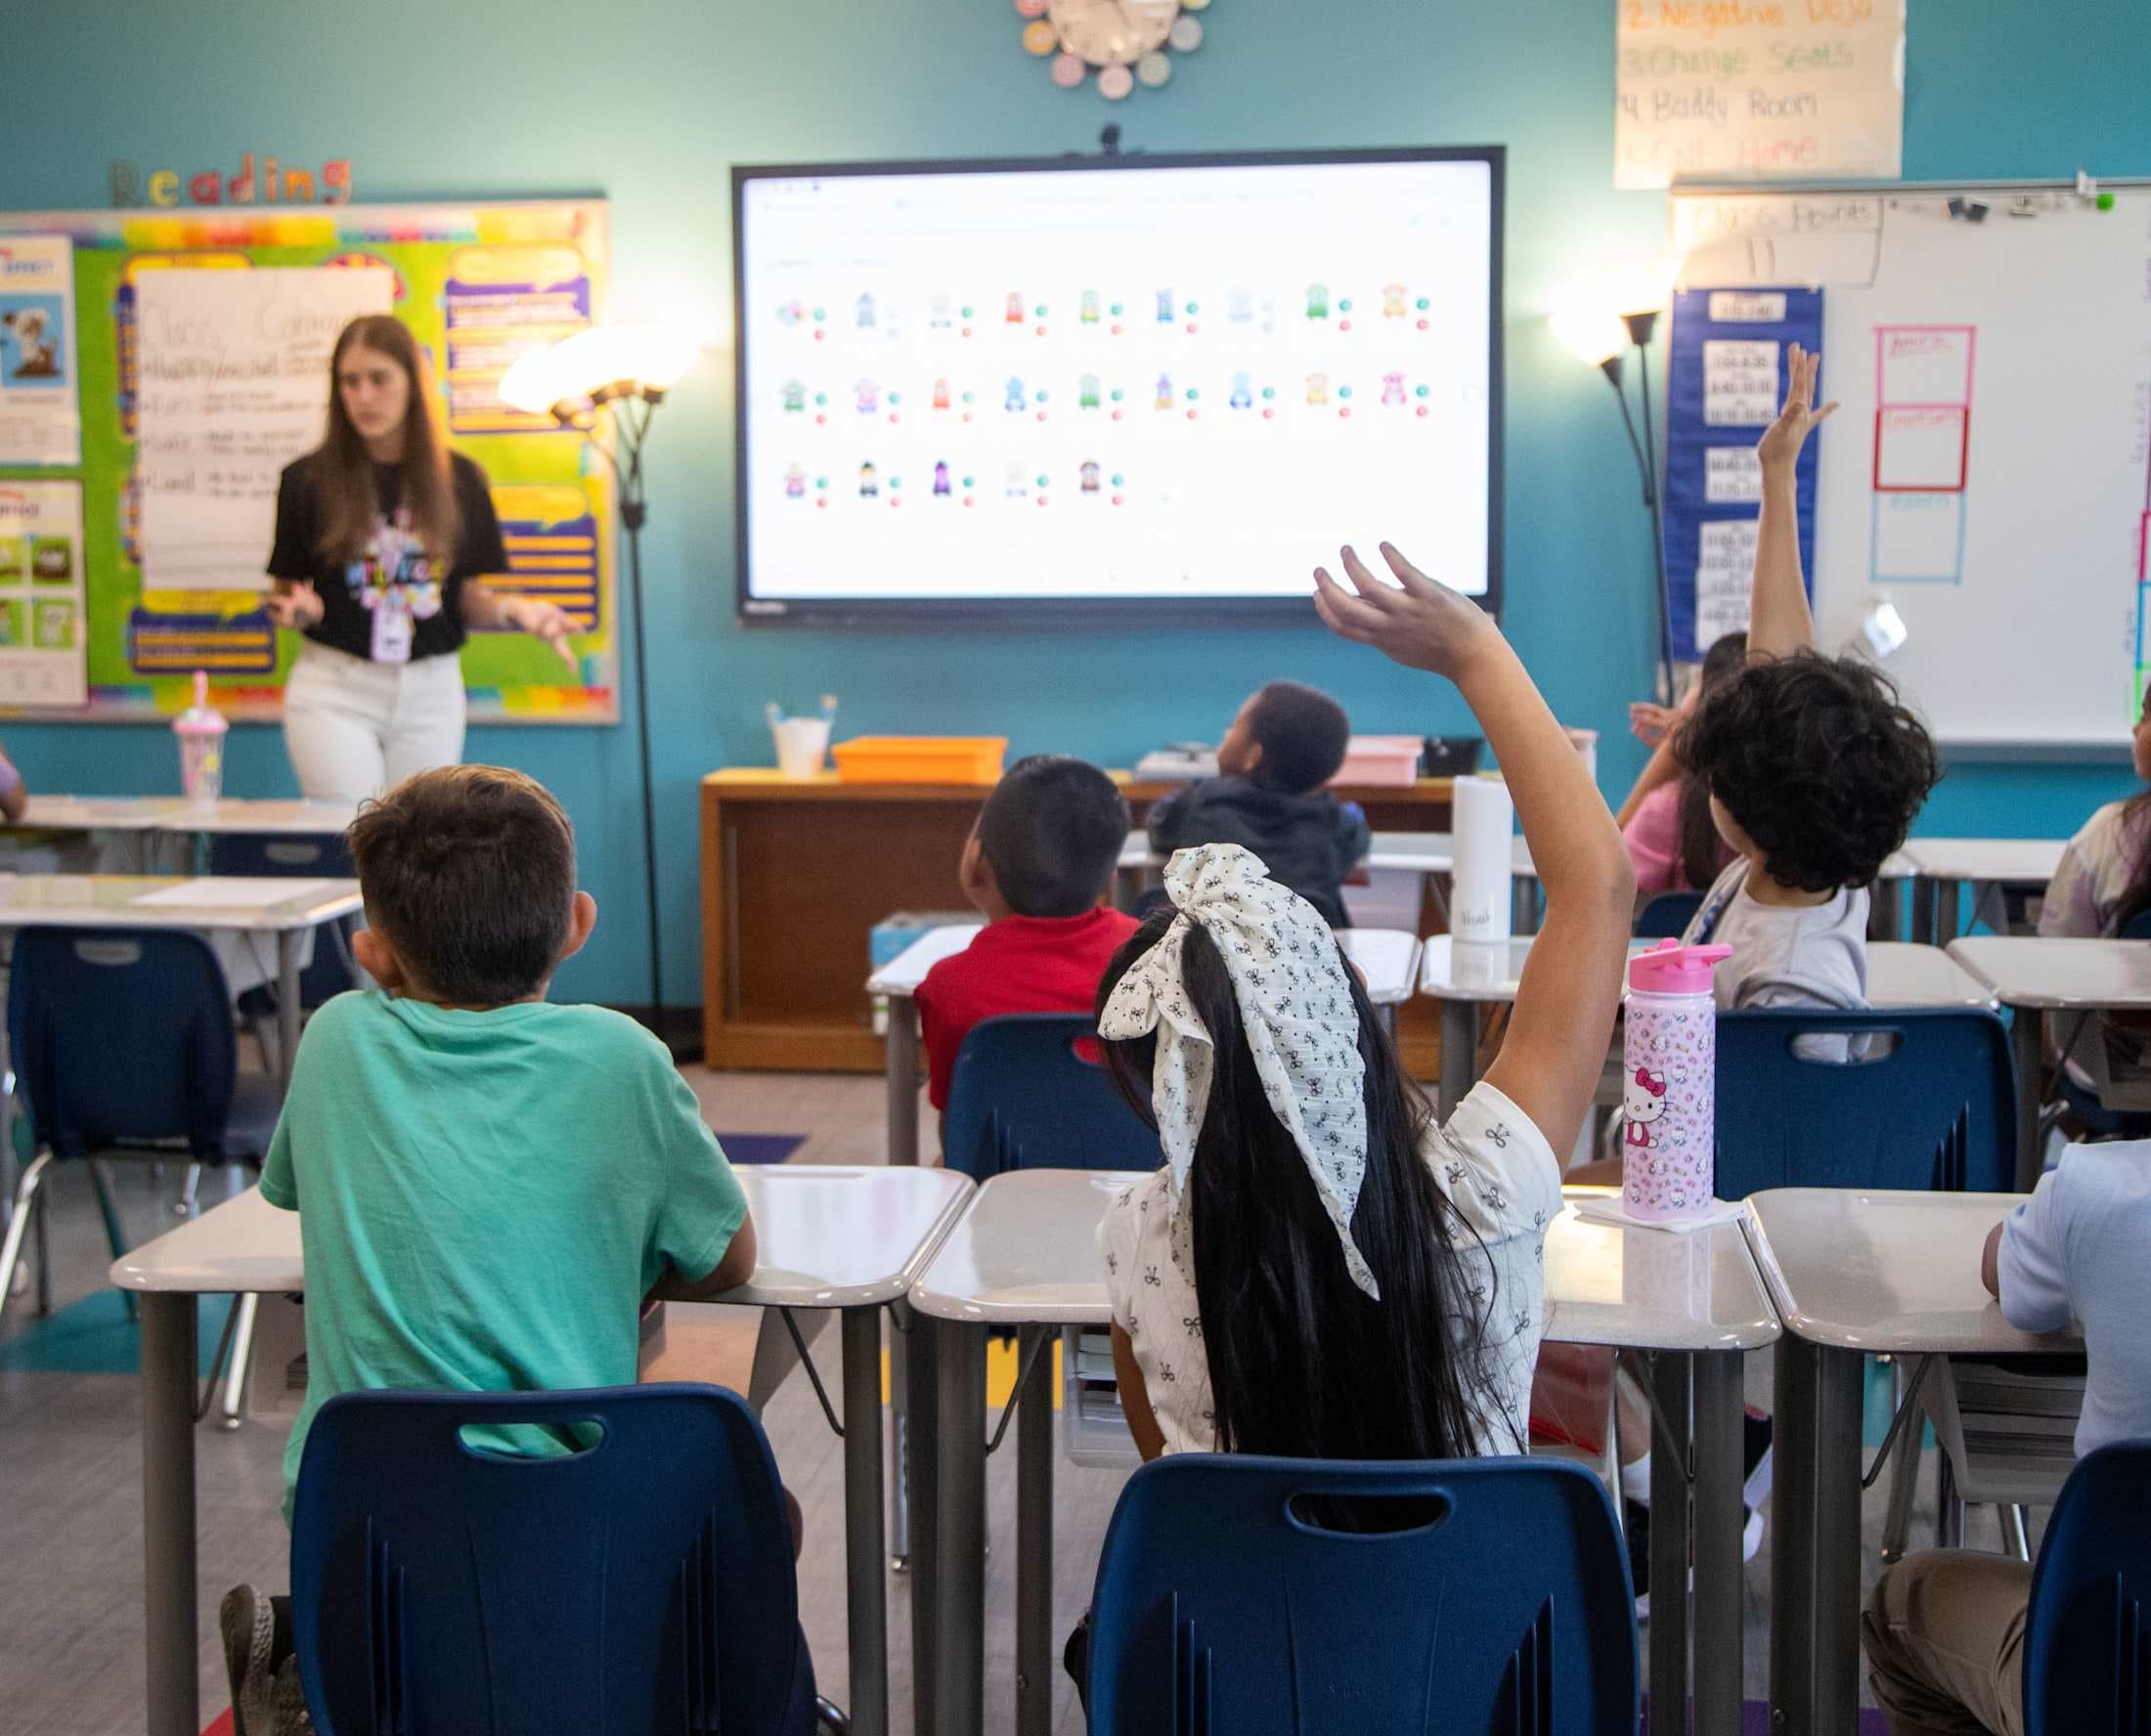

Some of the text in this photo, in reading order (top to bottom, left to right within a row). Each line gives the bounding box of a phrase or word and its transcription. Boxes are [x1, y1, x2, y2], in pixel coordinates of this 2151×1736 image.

[1647, 43, 1749, 82] Change
[1767, 40, 1854, 74] Seats
[1746, 86, 1820, 119] Room
[1735, 135, 1820, 168] Home
[110, 151, 353, 209] Reading
